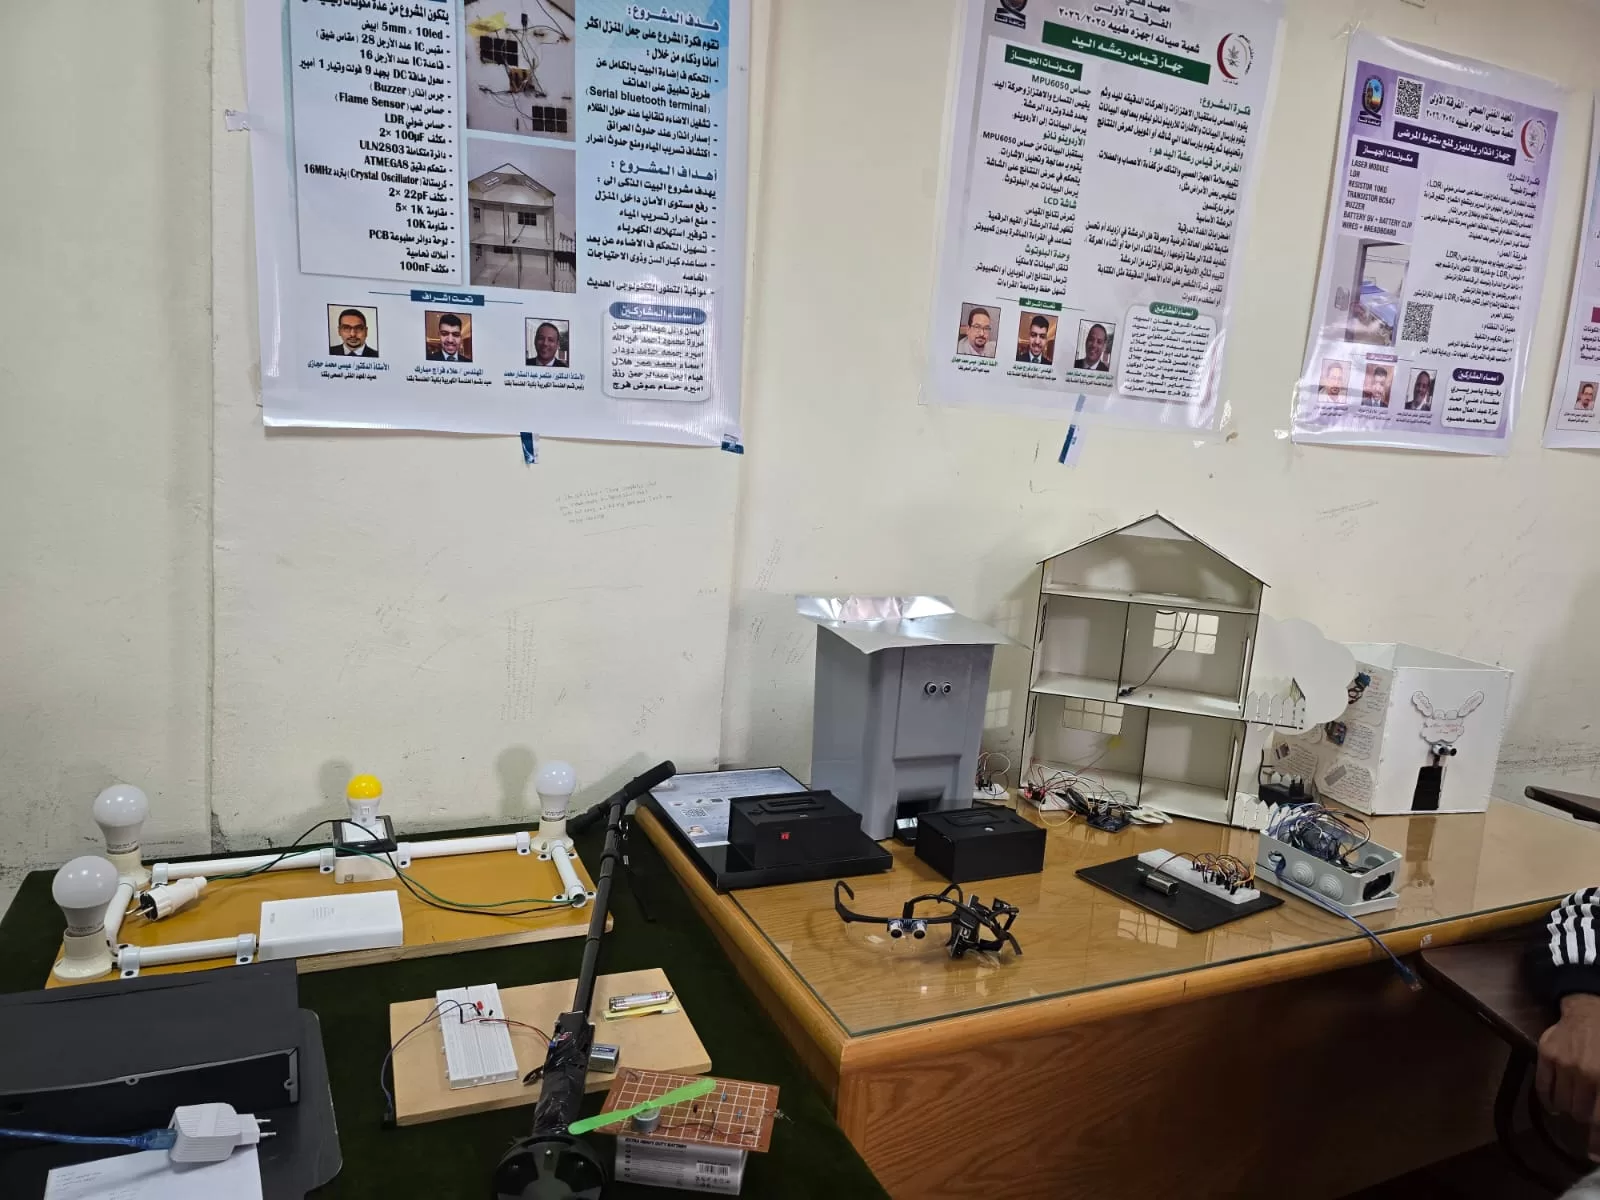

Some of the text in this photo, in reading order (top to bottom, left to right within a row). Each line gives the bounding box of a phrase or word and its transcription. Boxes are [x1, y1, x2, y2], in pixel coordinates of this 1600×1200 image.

[390, 5, 399, 15] من
[400, 4, 426, 19] المشروع
[382, 23, 406, 34] 5mm
[361, 34, 375, 44] 28
[658, 31, 683, 44] المشروع
[1072, 36, 1095, 48] اليد
[414, 42, 424, 51] IC
[1181, 40, 1200, 53] شعبة
[360, 49, 373, 59] 16
[671, 54, 680, 63] من
[1128, 54, 1158, 65] قياس
[413, 56, 423, 66] IC
[1159, 59, 1184, 73] جهاز
[365, 65, 372, 75] 9
[394, 69, 407, 79] DC
[1031, 75, 1069, 90] MPU6050
[620, 90, 666, 107] bluetooth
[385, 113, 404, 124] LDR
[360, 140, 405, 154] ULN2803
[304, 164, 332, 176] 16MHz
[1352, 159, 1389, 173] LASER MODULE
[404, 189, 428, 201] 22pF
[1044, 196, 1059, 206] LCD
[1345, 201, 1365, 210] BUZZER
[411, 205, 424, 214] 1K
[406, 219, 426, 229] 10K
[369, 229, 389, 240] PCB
[400, 261, 431, 272] 100nF
